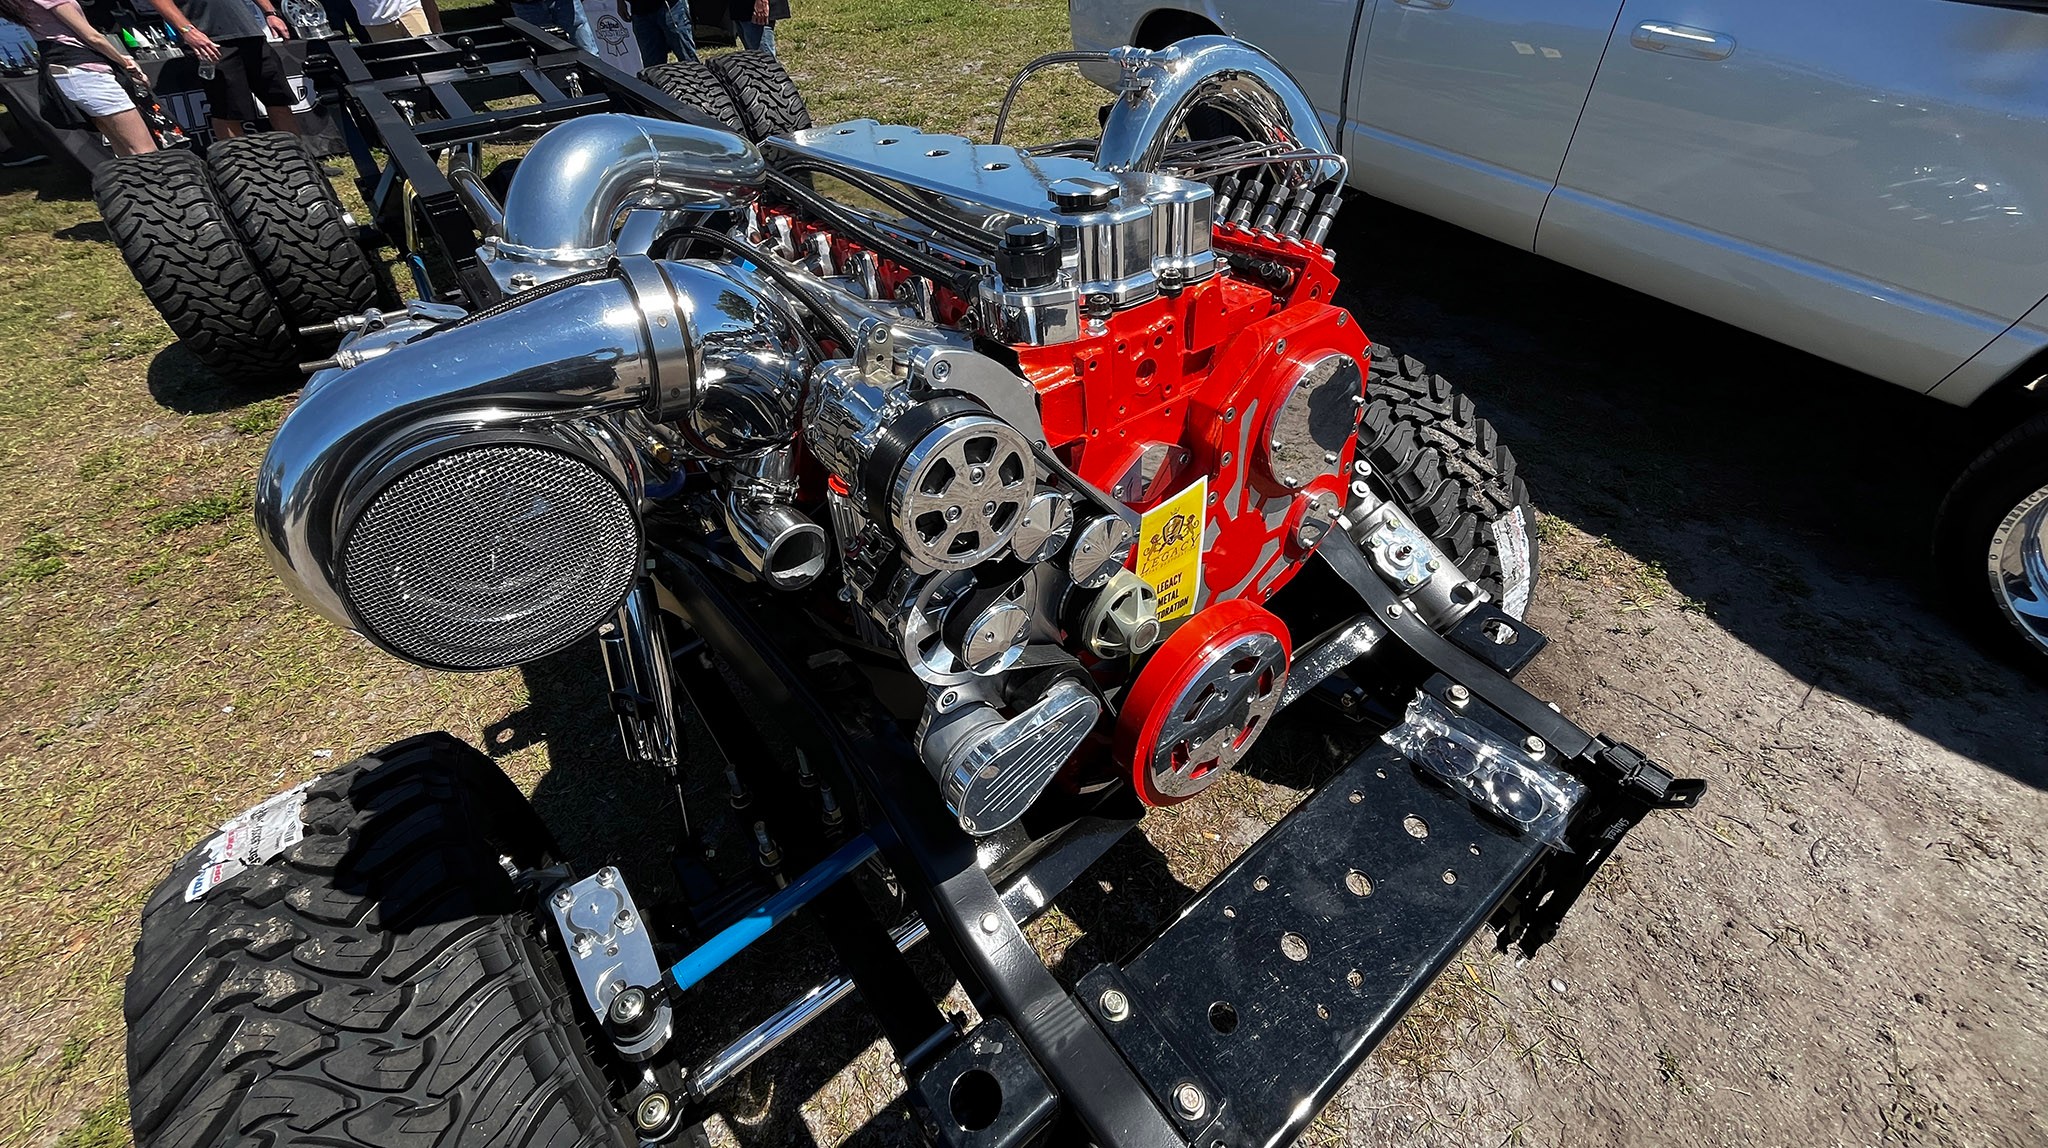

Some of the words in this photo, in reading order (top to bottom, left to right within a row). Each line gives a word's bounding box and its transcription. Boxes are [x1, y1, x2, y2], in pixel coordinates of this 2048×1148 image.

[1140, 533, 1201, 576] LEGACY
[1156, 572, 1183, 594] LEGACY
[1157, 589, 1179, 607] METAL
[1157, 596, 1190, 620] TORATION
